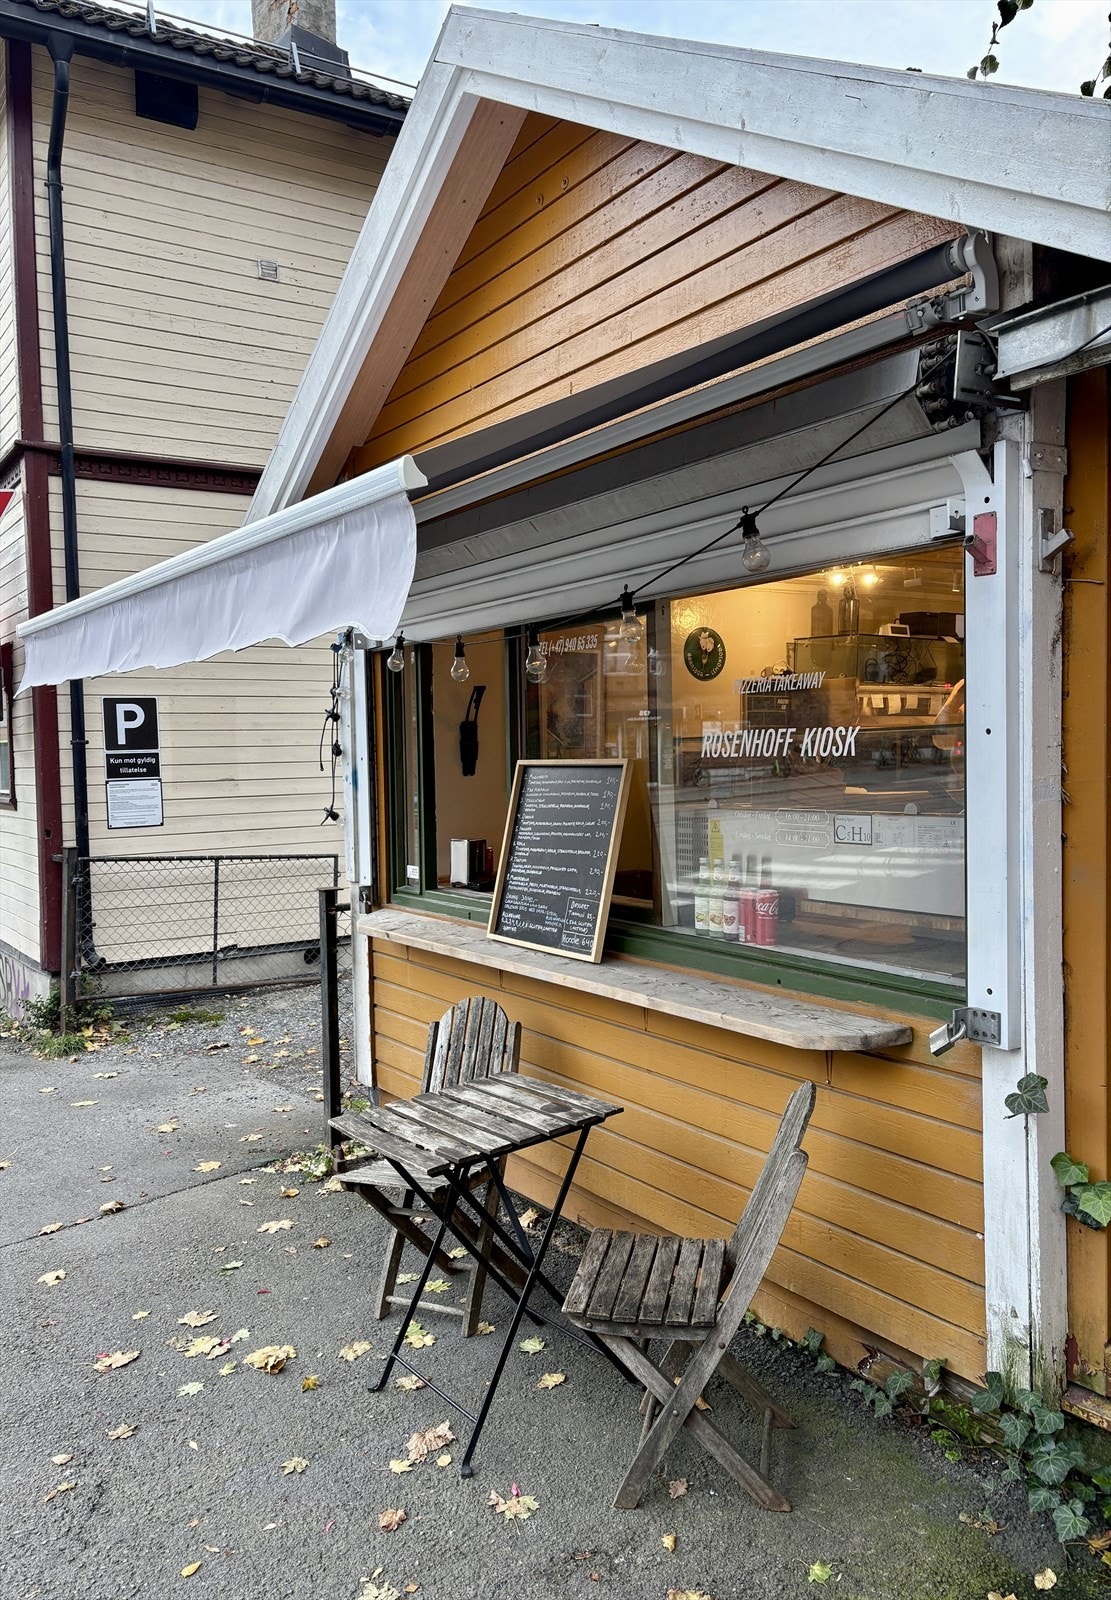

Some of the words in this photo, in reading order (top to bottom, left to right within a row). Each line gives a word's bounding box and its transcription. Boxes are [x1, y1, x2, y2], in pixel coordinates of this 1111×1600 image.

[733, 676, 772, 694] PIZZERIA
[773, 671, 826, 691] TAKEAWAY
[116, 703, 145, 745] P
[701, 727, 796, 758] ROSENHOFF
[800, 726, 861, 757] KIOSK
[137, 756, 156, 766] gyldig
